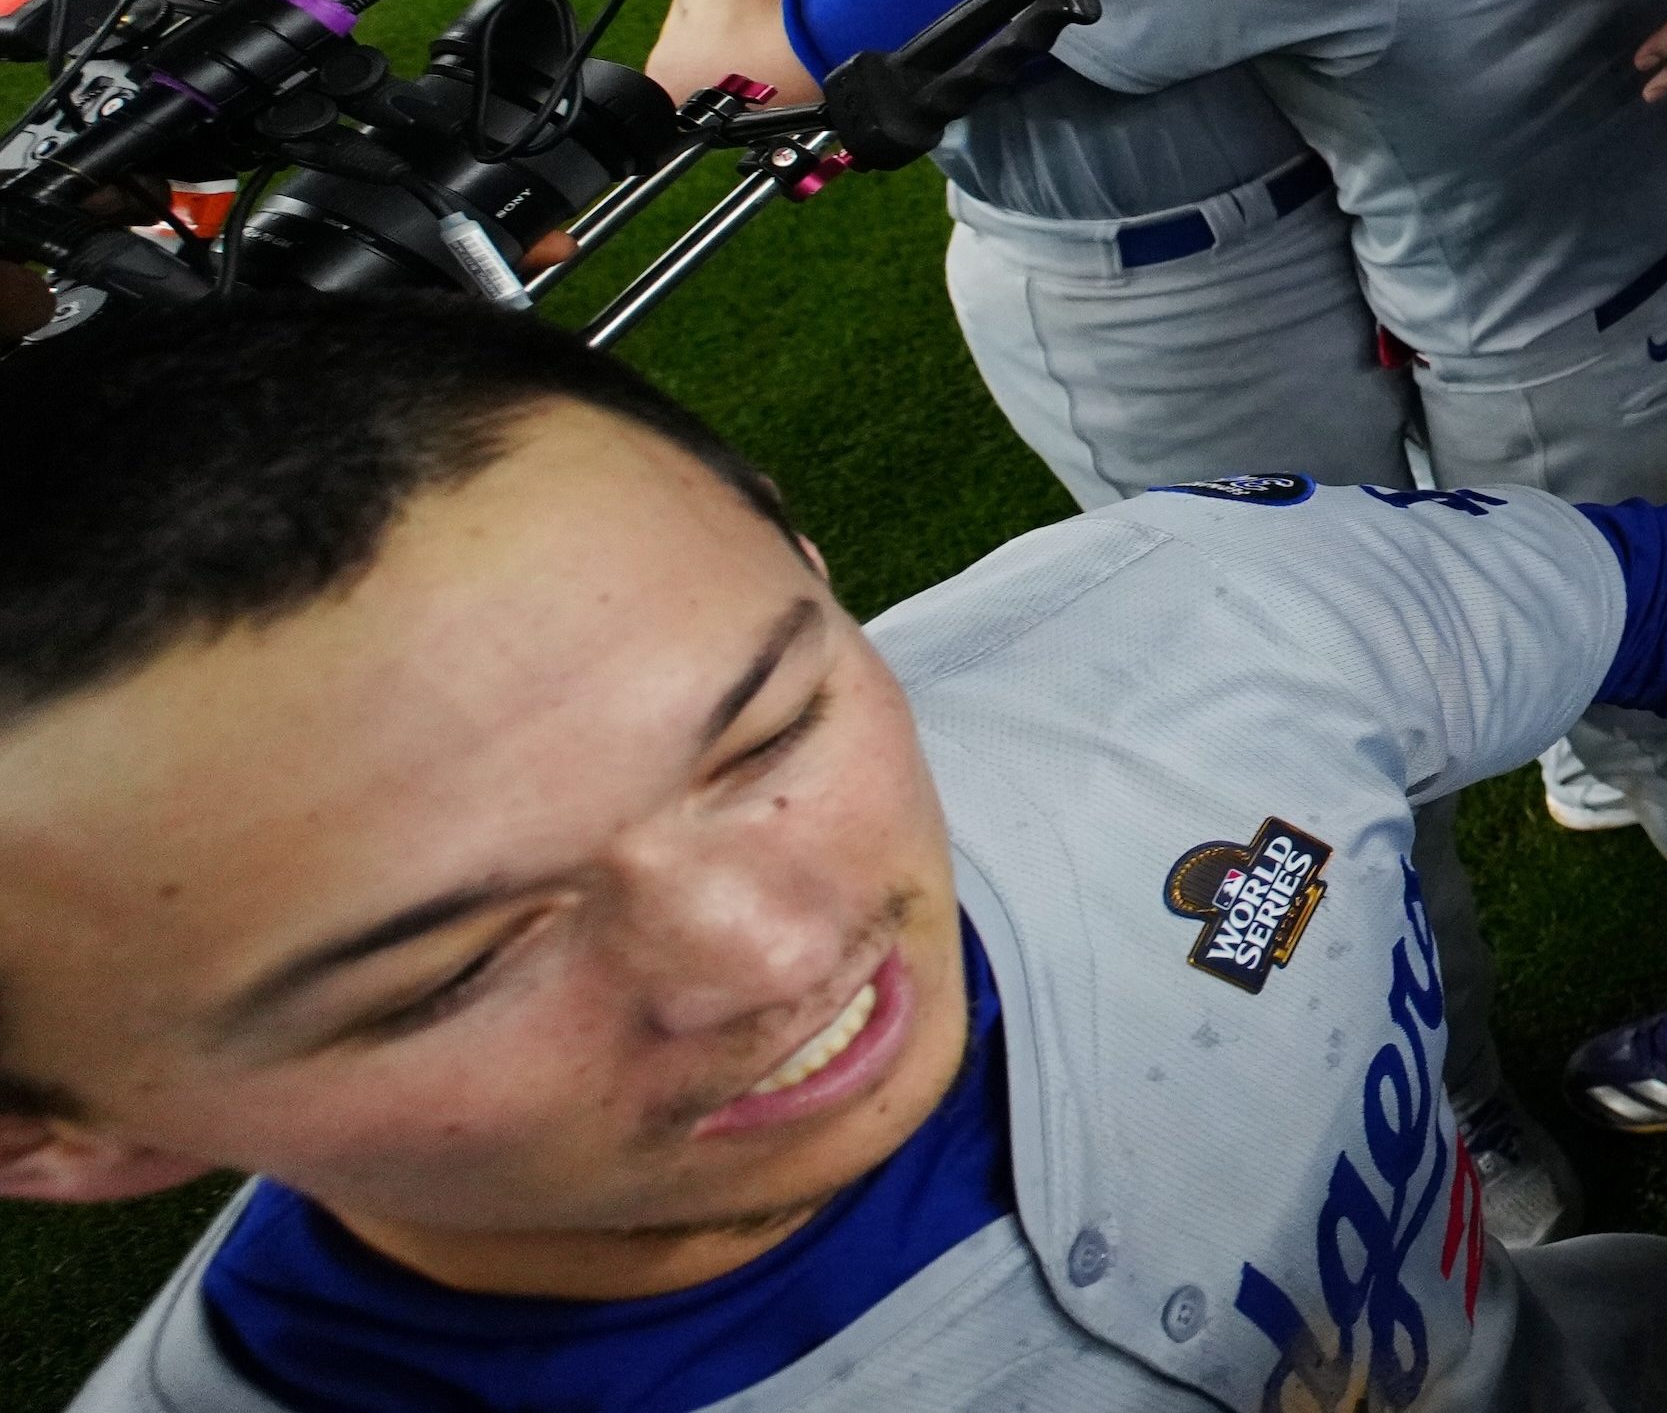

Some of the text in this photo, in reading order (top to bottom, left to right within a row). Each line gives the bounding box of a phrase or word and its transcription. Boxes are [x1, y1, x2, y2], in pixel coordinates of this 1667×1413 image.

[495, 187, 532, 220] SONY
[1206, 835, 1294, 961] WORLD
[1234, 850, 1313, 970] SERIES
